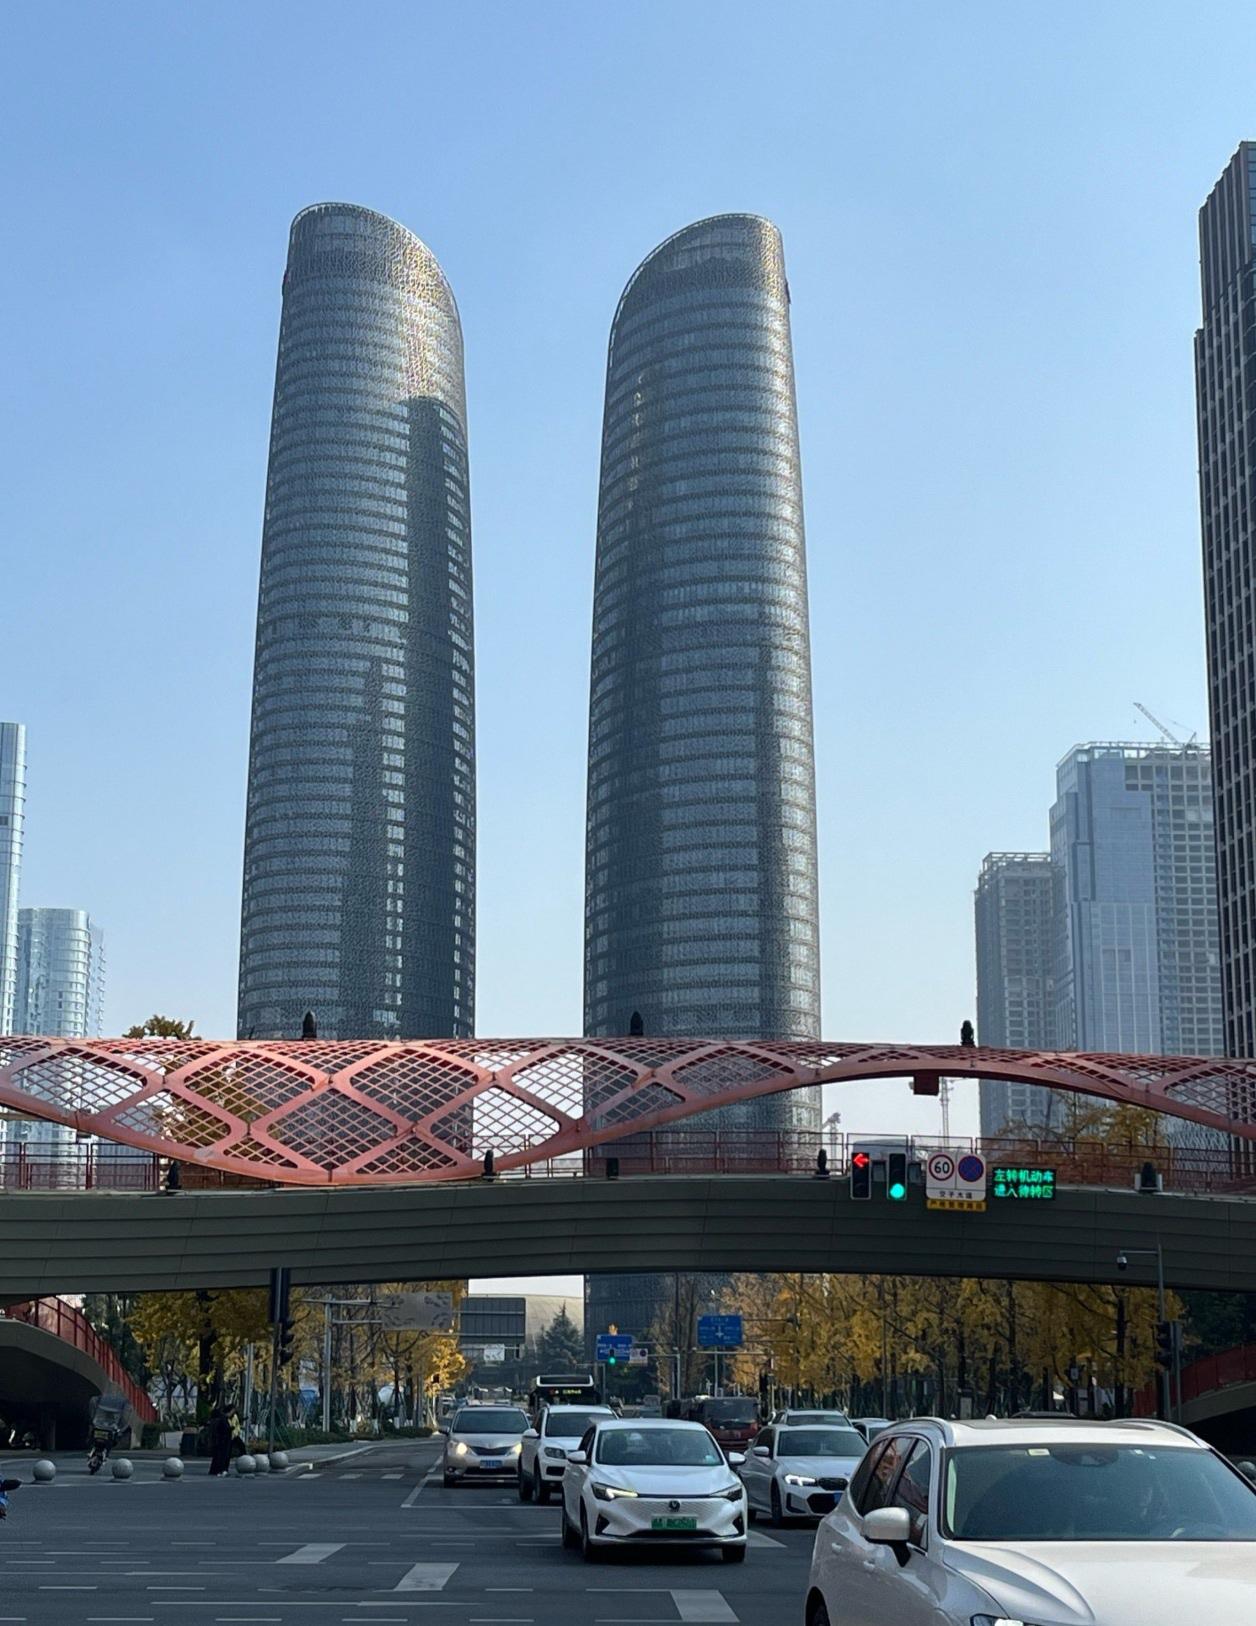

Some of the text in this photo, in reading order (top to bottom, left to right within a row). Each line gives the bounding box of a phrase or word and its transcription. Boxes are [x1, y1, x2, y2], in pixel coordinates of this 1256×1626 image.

[934, 1161, 950, 1174] 60
[994, 1168, 1054, 1183] 左转机动车
[994, 1184, 1054, 1198] 进入待转区
